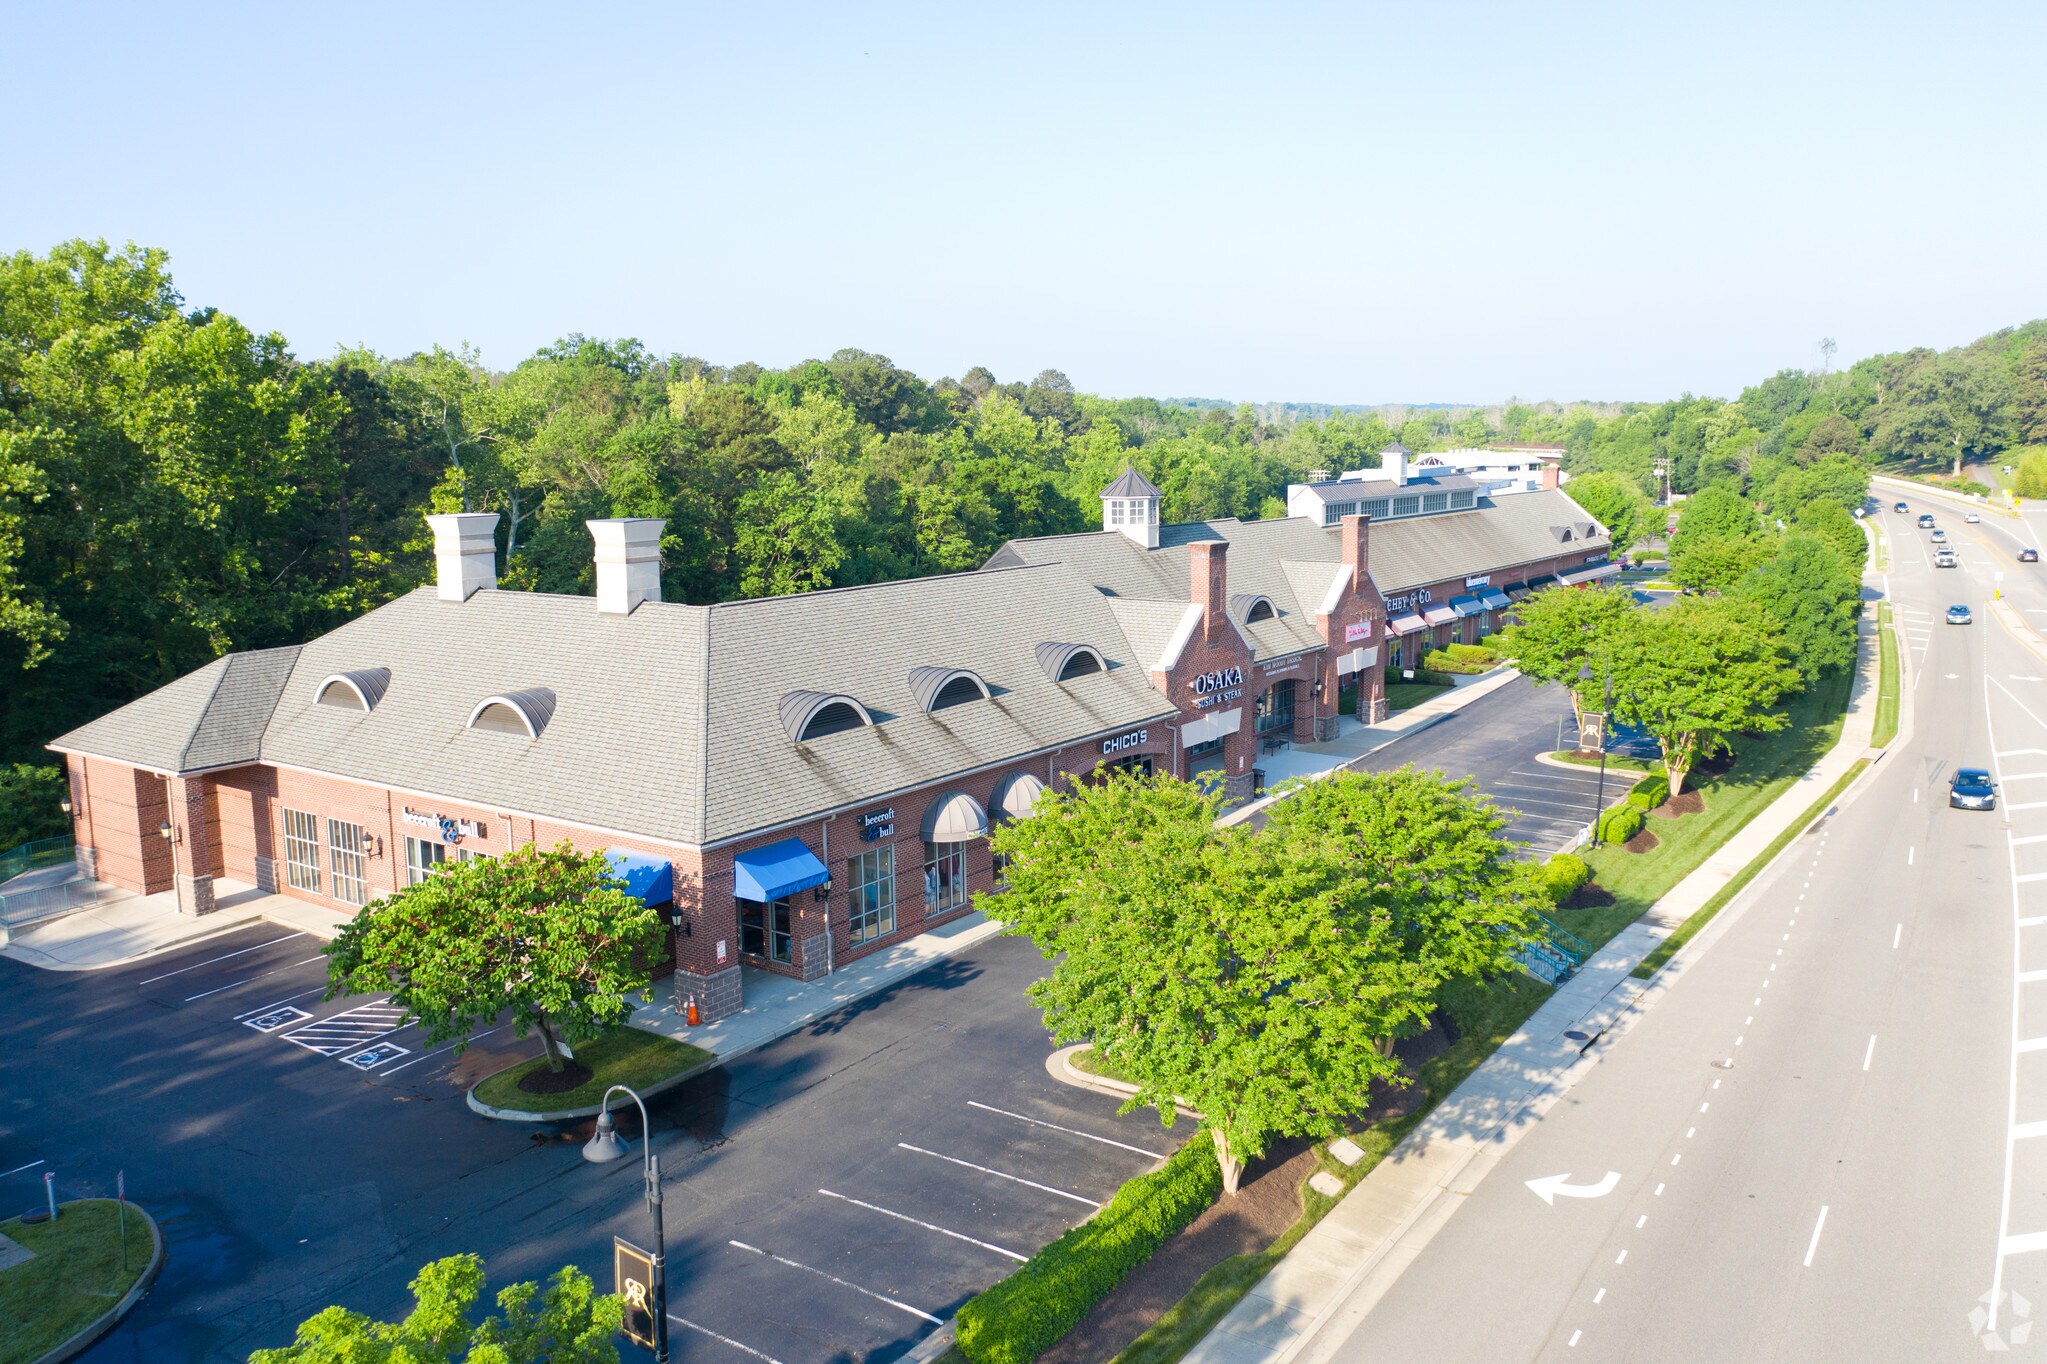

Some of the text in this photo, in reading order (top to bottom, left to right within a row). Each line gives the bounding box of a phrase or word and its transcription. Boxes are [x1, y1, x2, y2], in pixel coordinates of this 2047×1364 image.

[1196, 666, 1243, 694] OSAKA
[1198, 696, 1215, 709] SUSHI
[1224, 689, 1242, 701] STEAK
[1103, 730, 1148, 755] CHICO'S
[865, 808, 895, 826] beecroft
[442, 818, 459, 843] &
[879, 823, 894, 838] bull
